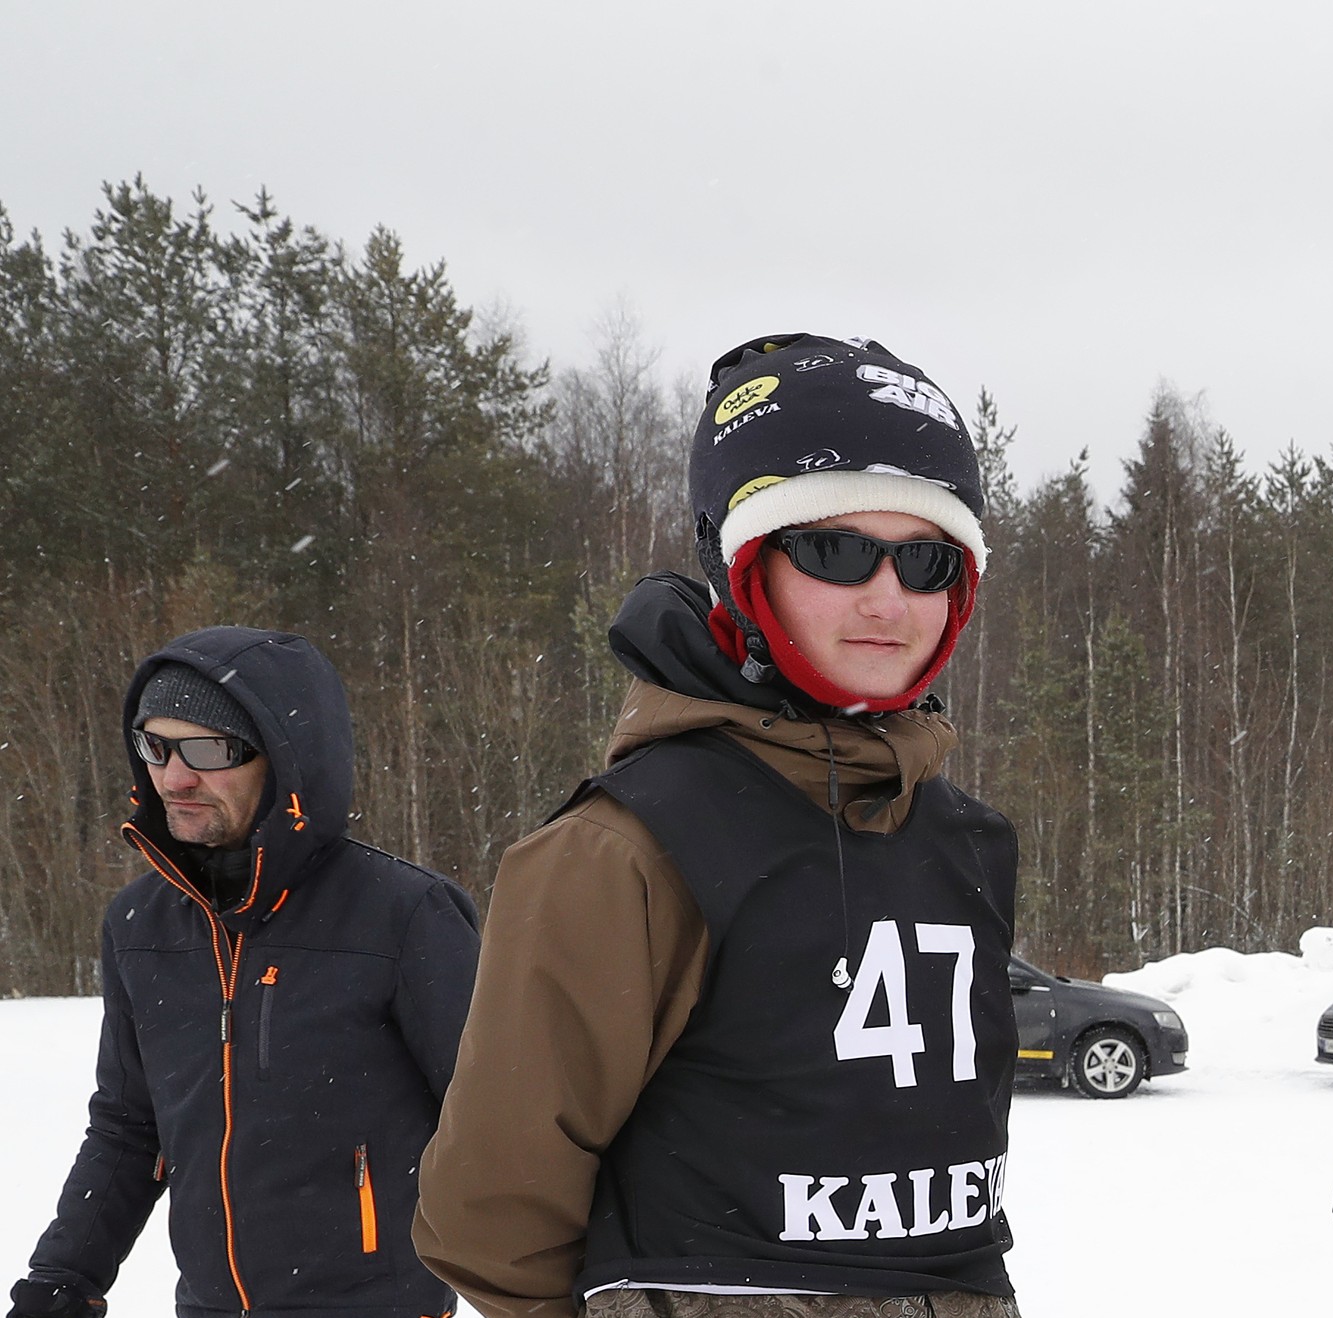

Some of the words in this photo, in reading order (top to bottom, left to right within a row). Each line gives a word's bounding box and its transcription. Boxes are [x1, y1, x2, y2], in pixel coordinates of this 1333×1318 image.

[713, 402, 782, 446] KALEVA
[868, 385, 960, 431] AIR
[833, 920, 978, 1088] 47
